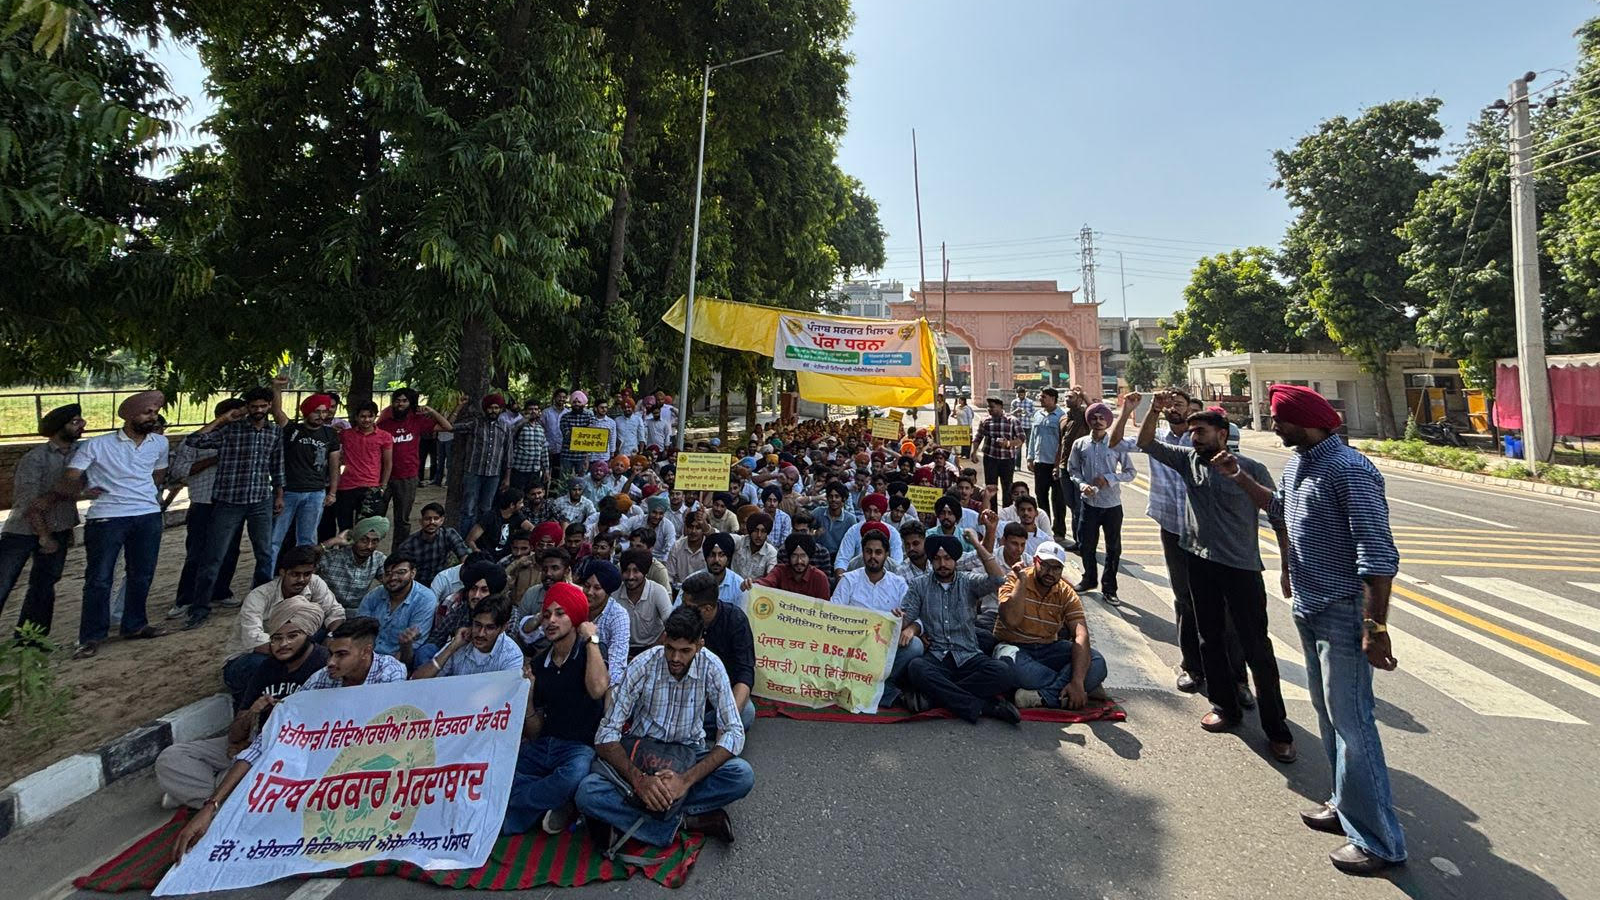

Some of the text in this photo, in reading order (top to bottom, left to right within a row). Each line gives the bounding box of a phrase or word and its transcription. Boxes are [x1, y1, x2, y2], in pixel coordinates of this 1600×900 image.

[807, 321, 831, 333] ਪੰਜਾਬ
[833, 326, 864, 335] ਸਰਕਾਰ
[812, 333, 886, 351] ਪੱਕਾ ਧਰਨਾ
[757, 632, 785, 650] ਪੰਜਾਬ
[789, 639, 806, 650] ਭਰ
[810, 639, 819, 652] ਦੇ
[801, 664, 821, 678] ਪਾਸ
[278, 720, 330, 752] ਖੇਤੀਬਾੜੀ
[325, 715, 409, 750] ਵਿਦਿਆਰਥੀਆਂ
[406, 719, 433, 741] ਨਾਲ
[431, 710, 475, 738] ਵਿਤਕਰਾ
[475, 705, 493, 732] ਬੰਦ
[490, 702, 512, 731] ਕਰੋ
[247, 759, 489, 821] ਪੰਜਾਬ ਸਰਕਾਰ ਮੁਰਦਾਬਾਦ
[246, 837, 305, 860] ਖੇਤੀਬਾੜੀ
[300, 834, 377, 856] ਵਿਦਿਆਰਥੀ
[441, 828, 474, 851] ਪੰਜਾਬ
